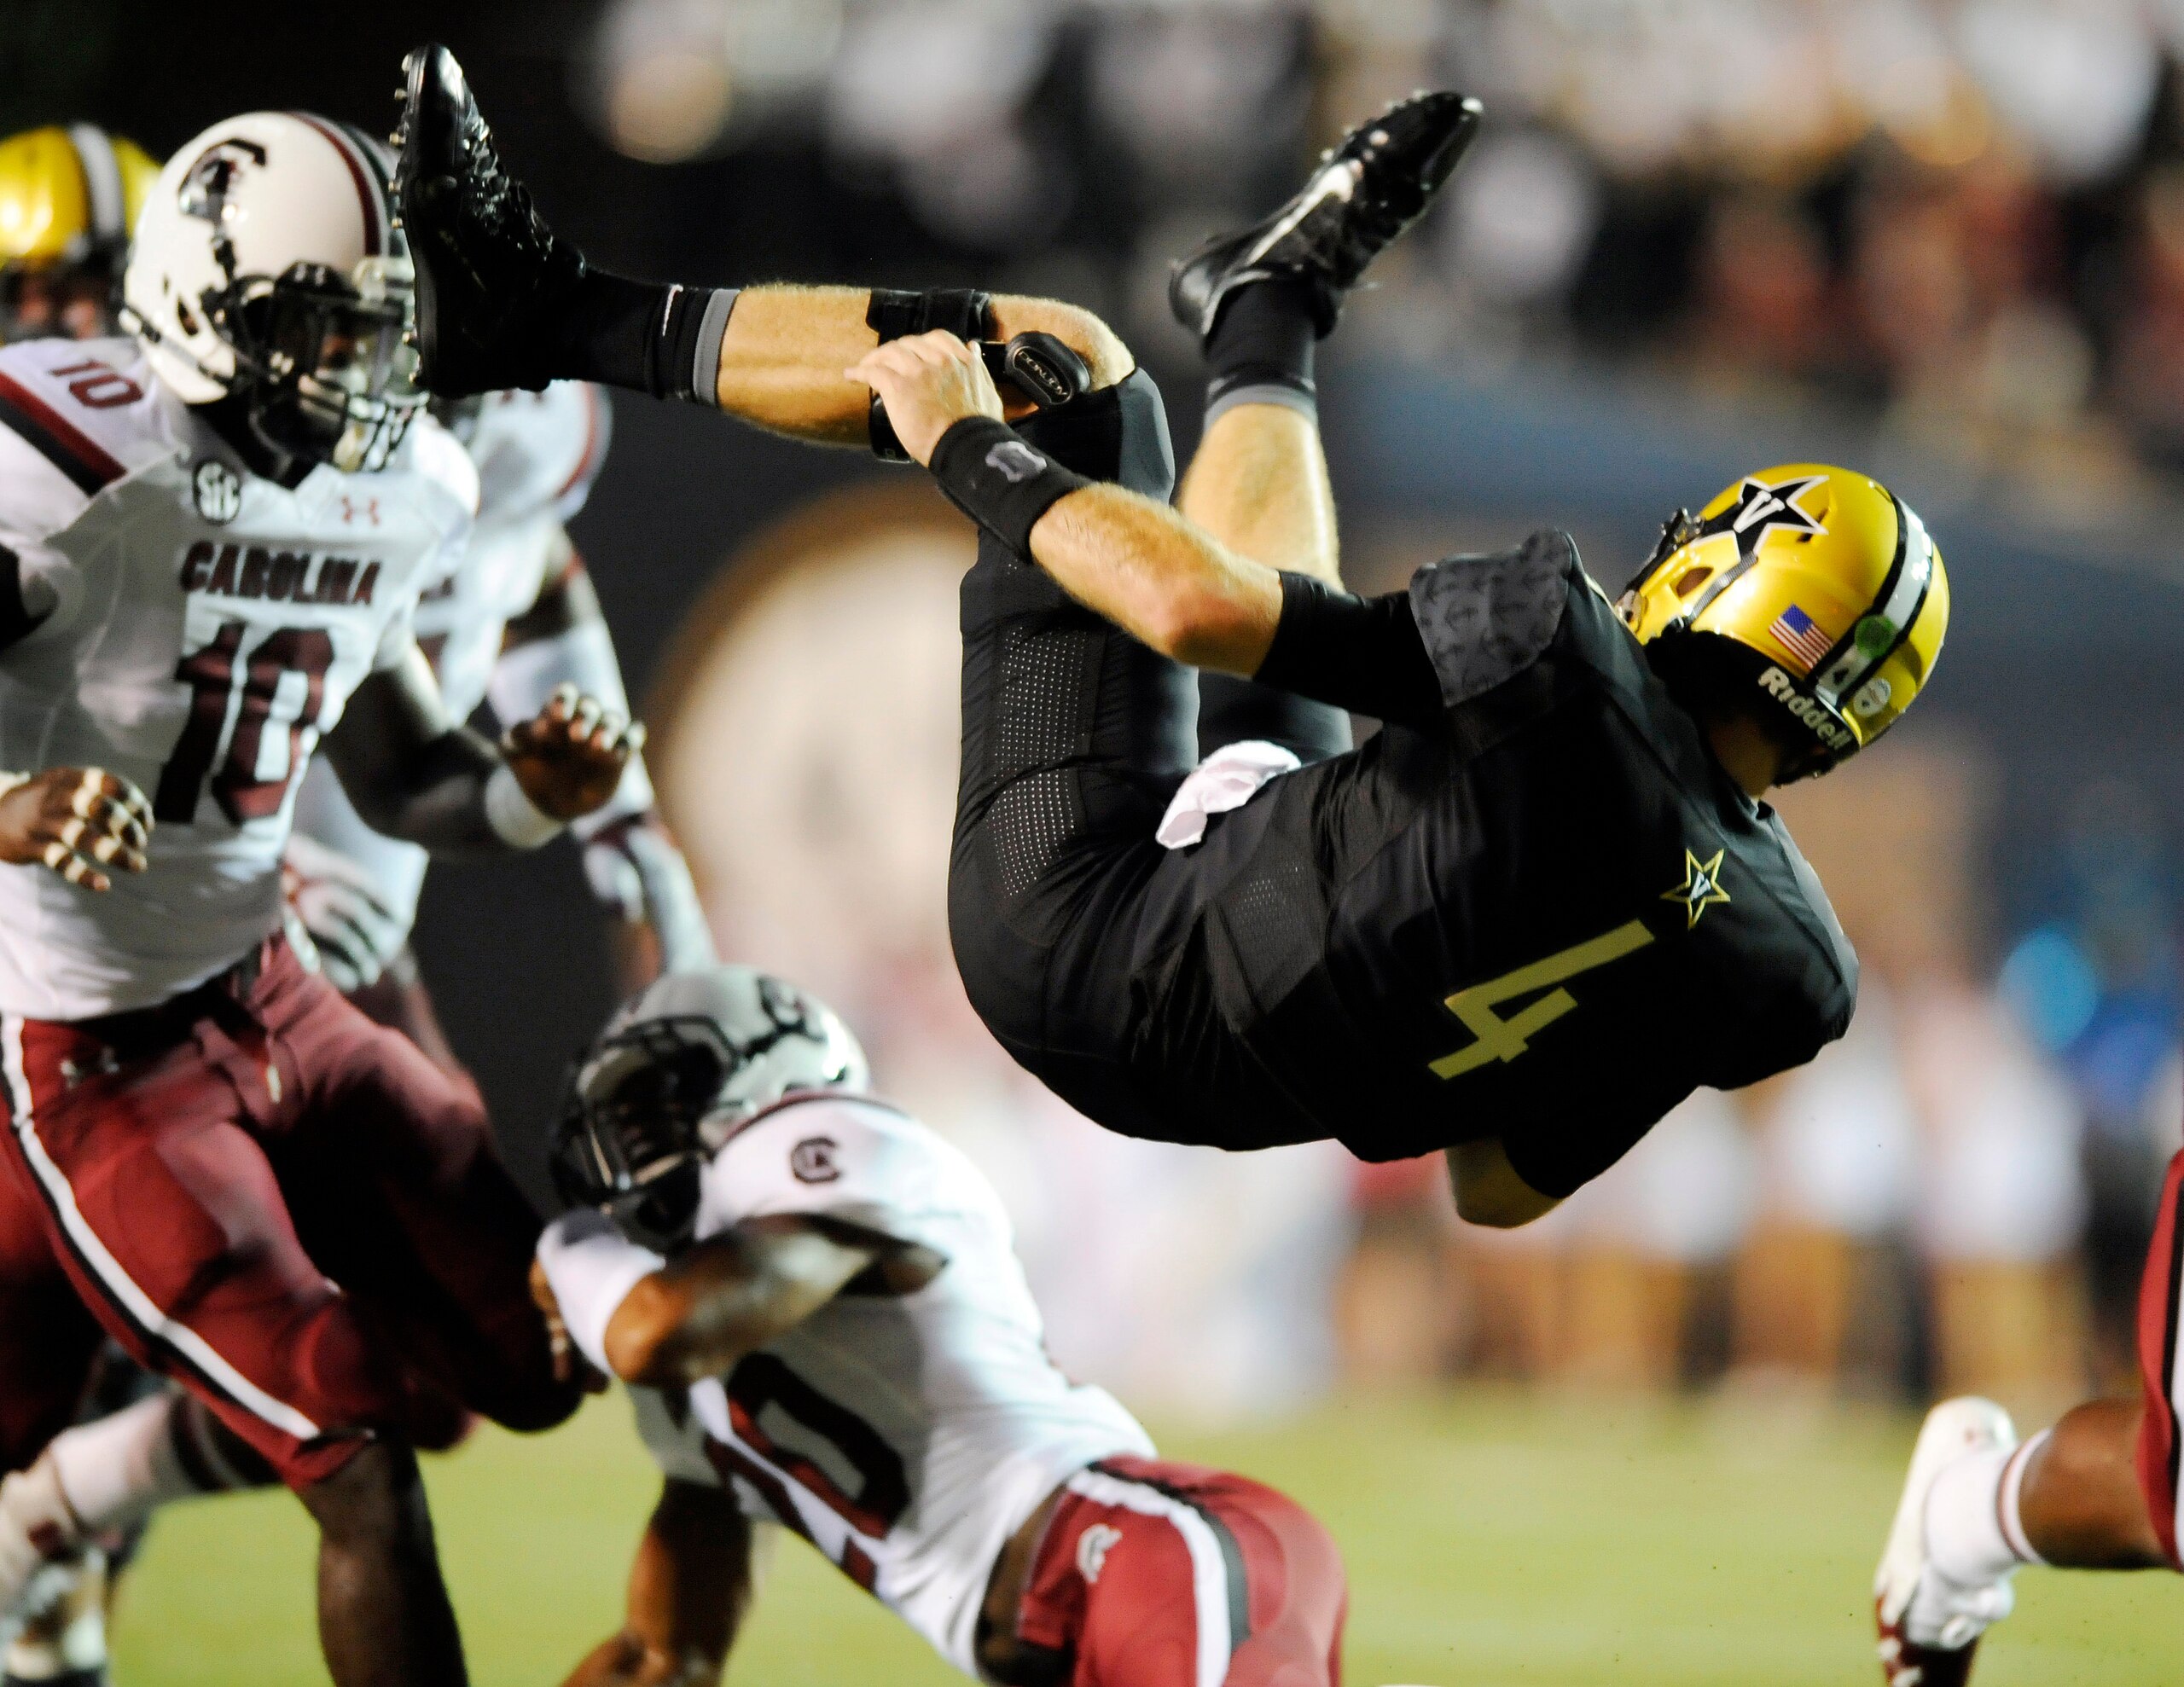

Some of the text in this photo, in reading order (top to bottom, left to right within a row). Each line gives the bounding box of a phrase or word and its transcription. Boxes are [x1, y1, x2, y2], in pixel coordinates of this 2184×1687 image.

[48, 358, 145, 410] 10
[179, 540, 380, 606] CAROLINA
[154, 619, 336, 826] 10
[1757, 666, 1852, 749] Riddell
[1428, 919, 1655, 1081] 4
